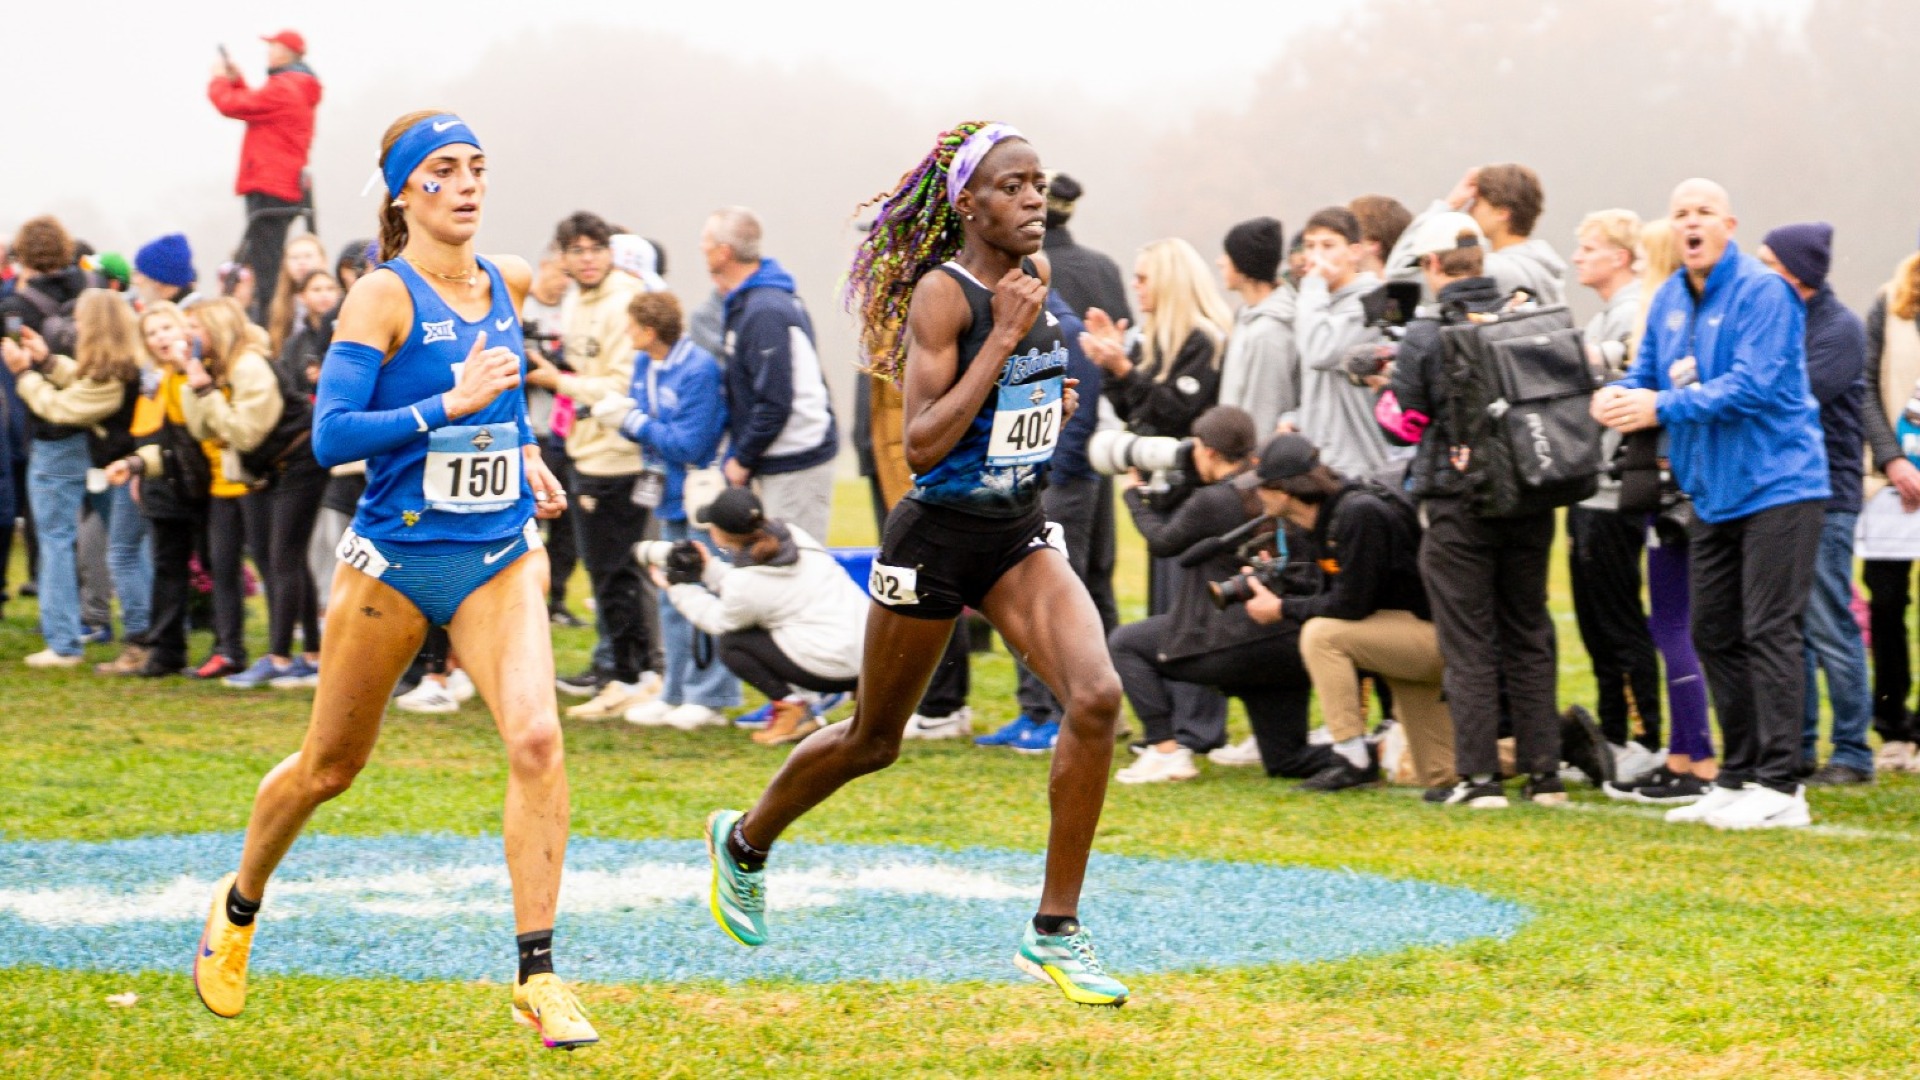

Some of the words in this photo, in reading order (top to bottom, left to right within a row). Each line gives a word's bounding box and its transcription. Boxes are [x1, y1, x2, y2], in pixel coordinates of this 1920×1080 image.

[1007, 407, 1053, 451] 402
[1525, 412, 1554, 469] RVCA
[448, 455, 507, 497] 150
[873, 570, 902, 600] 02
